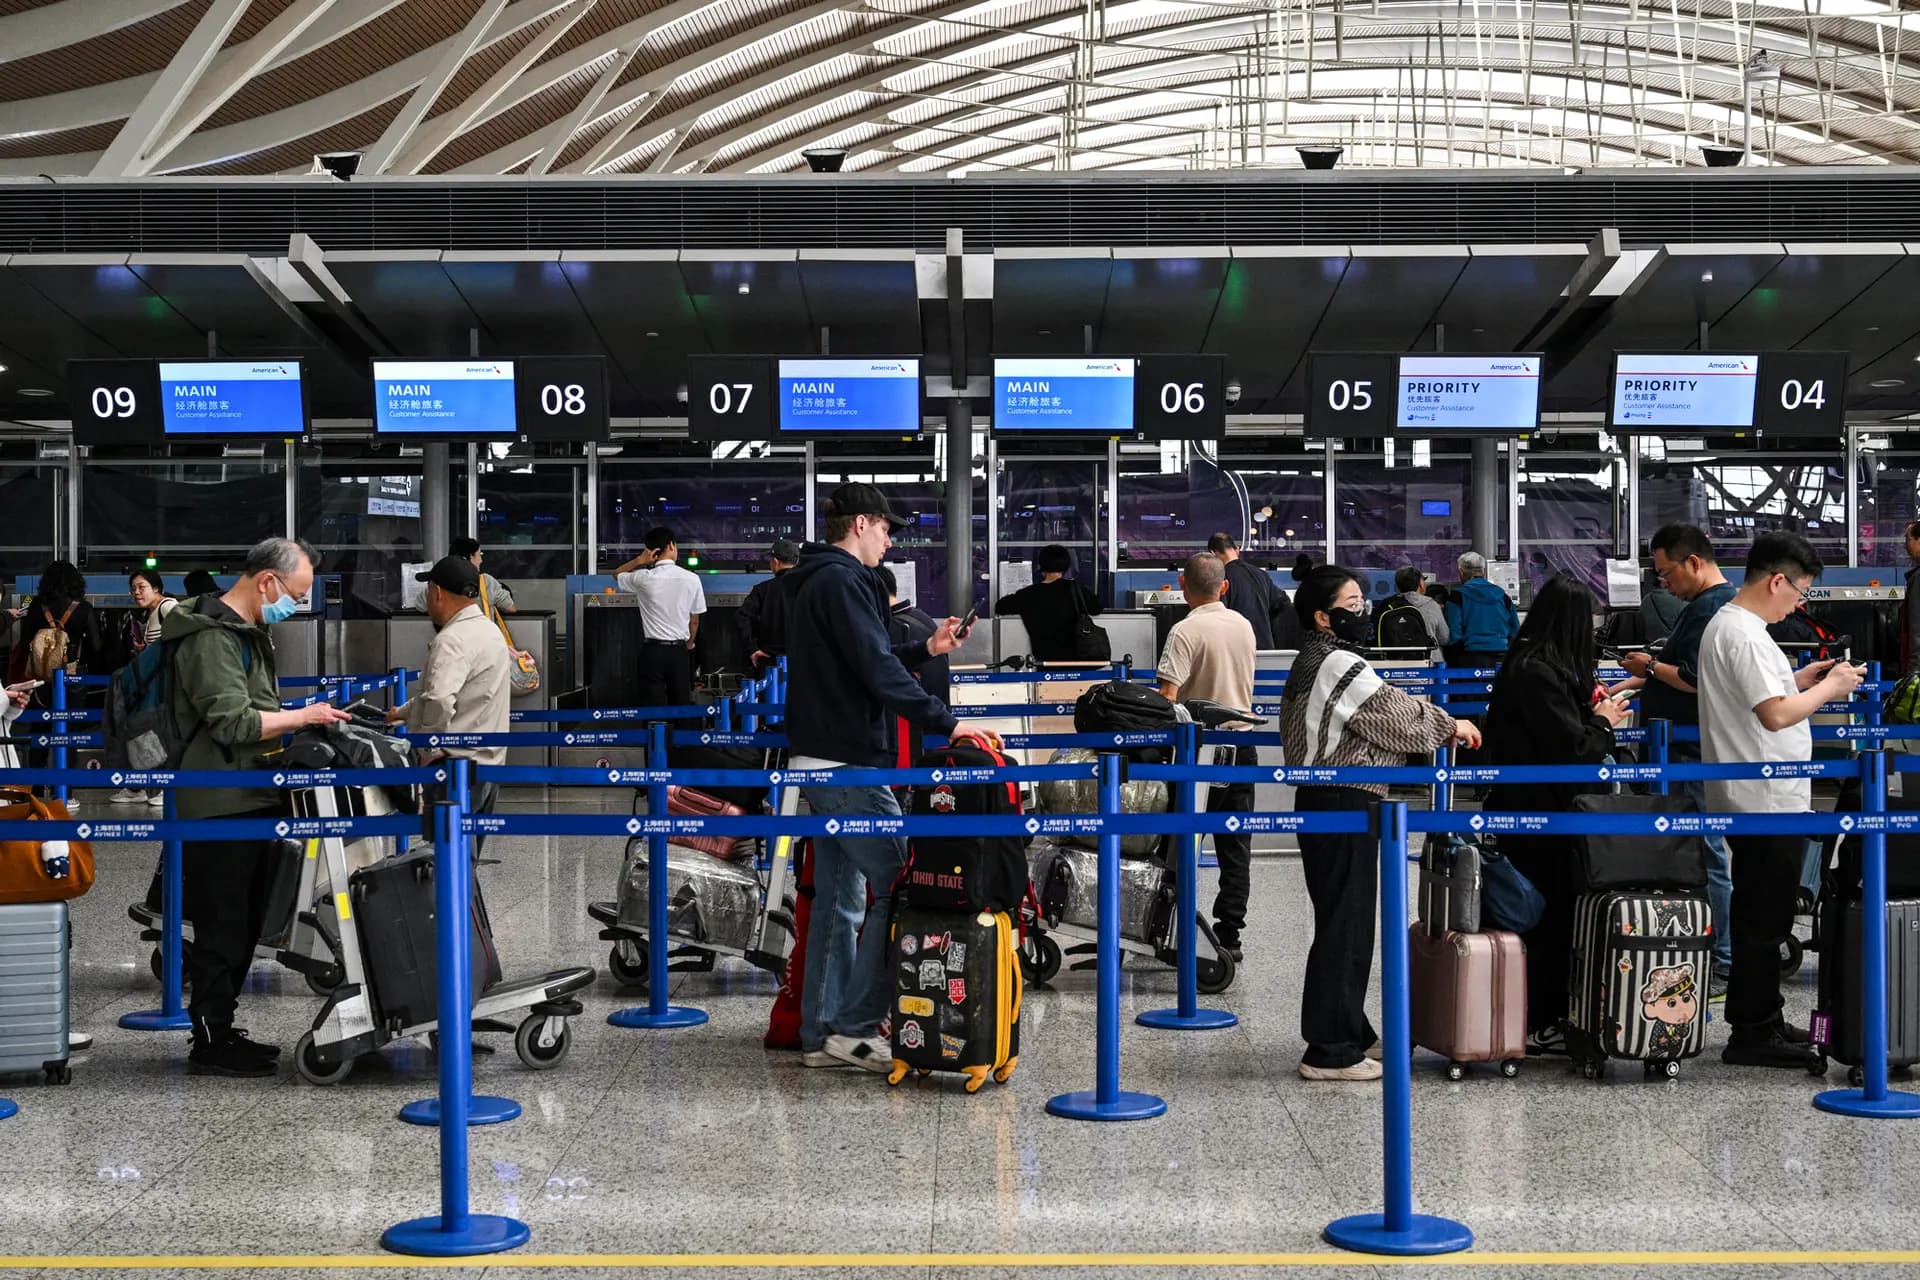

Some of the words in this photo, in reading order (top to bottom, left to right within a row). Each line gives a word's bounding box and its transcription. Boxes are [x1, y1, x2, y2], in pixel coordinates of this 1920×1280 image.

[174, 386, 216, 396] MAIN
[388, 385, 430, 396] MAIN
[792, 383, 834, 394] MAIN
[1008, 382, 1049, 392] MAIN
[1408, 383, 1480, 393] PRIORITY
[1625, 380, 1698, 391] PRIORITY
[542, 384, 586, 415] 08
[710, 383, 753, 414] 07
[1161, 382, 1205, 413] 06
[1328, 380, 1372, 411] 05
[1781, 379, 1825, 410] 04
[92, 387, 136, 418] 09
[176, 400, 229, 410] 经济舱旅客
[389, 400, 442, 410] 经济舱旅客
[792, 398, 846, 408] 经济舱旅客
[1008, 397, 1061, 407] 经济舱旅客
[913, 871, 934, 886] OHIO
[937, 874, 964, 890] STATE
